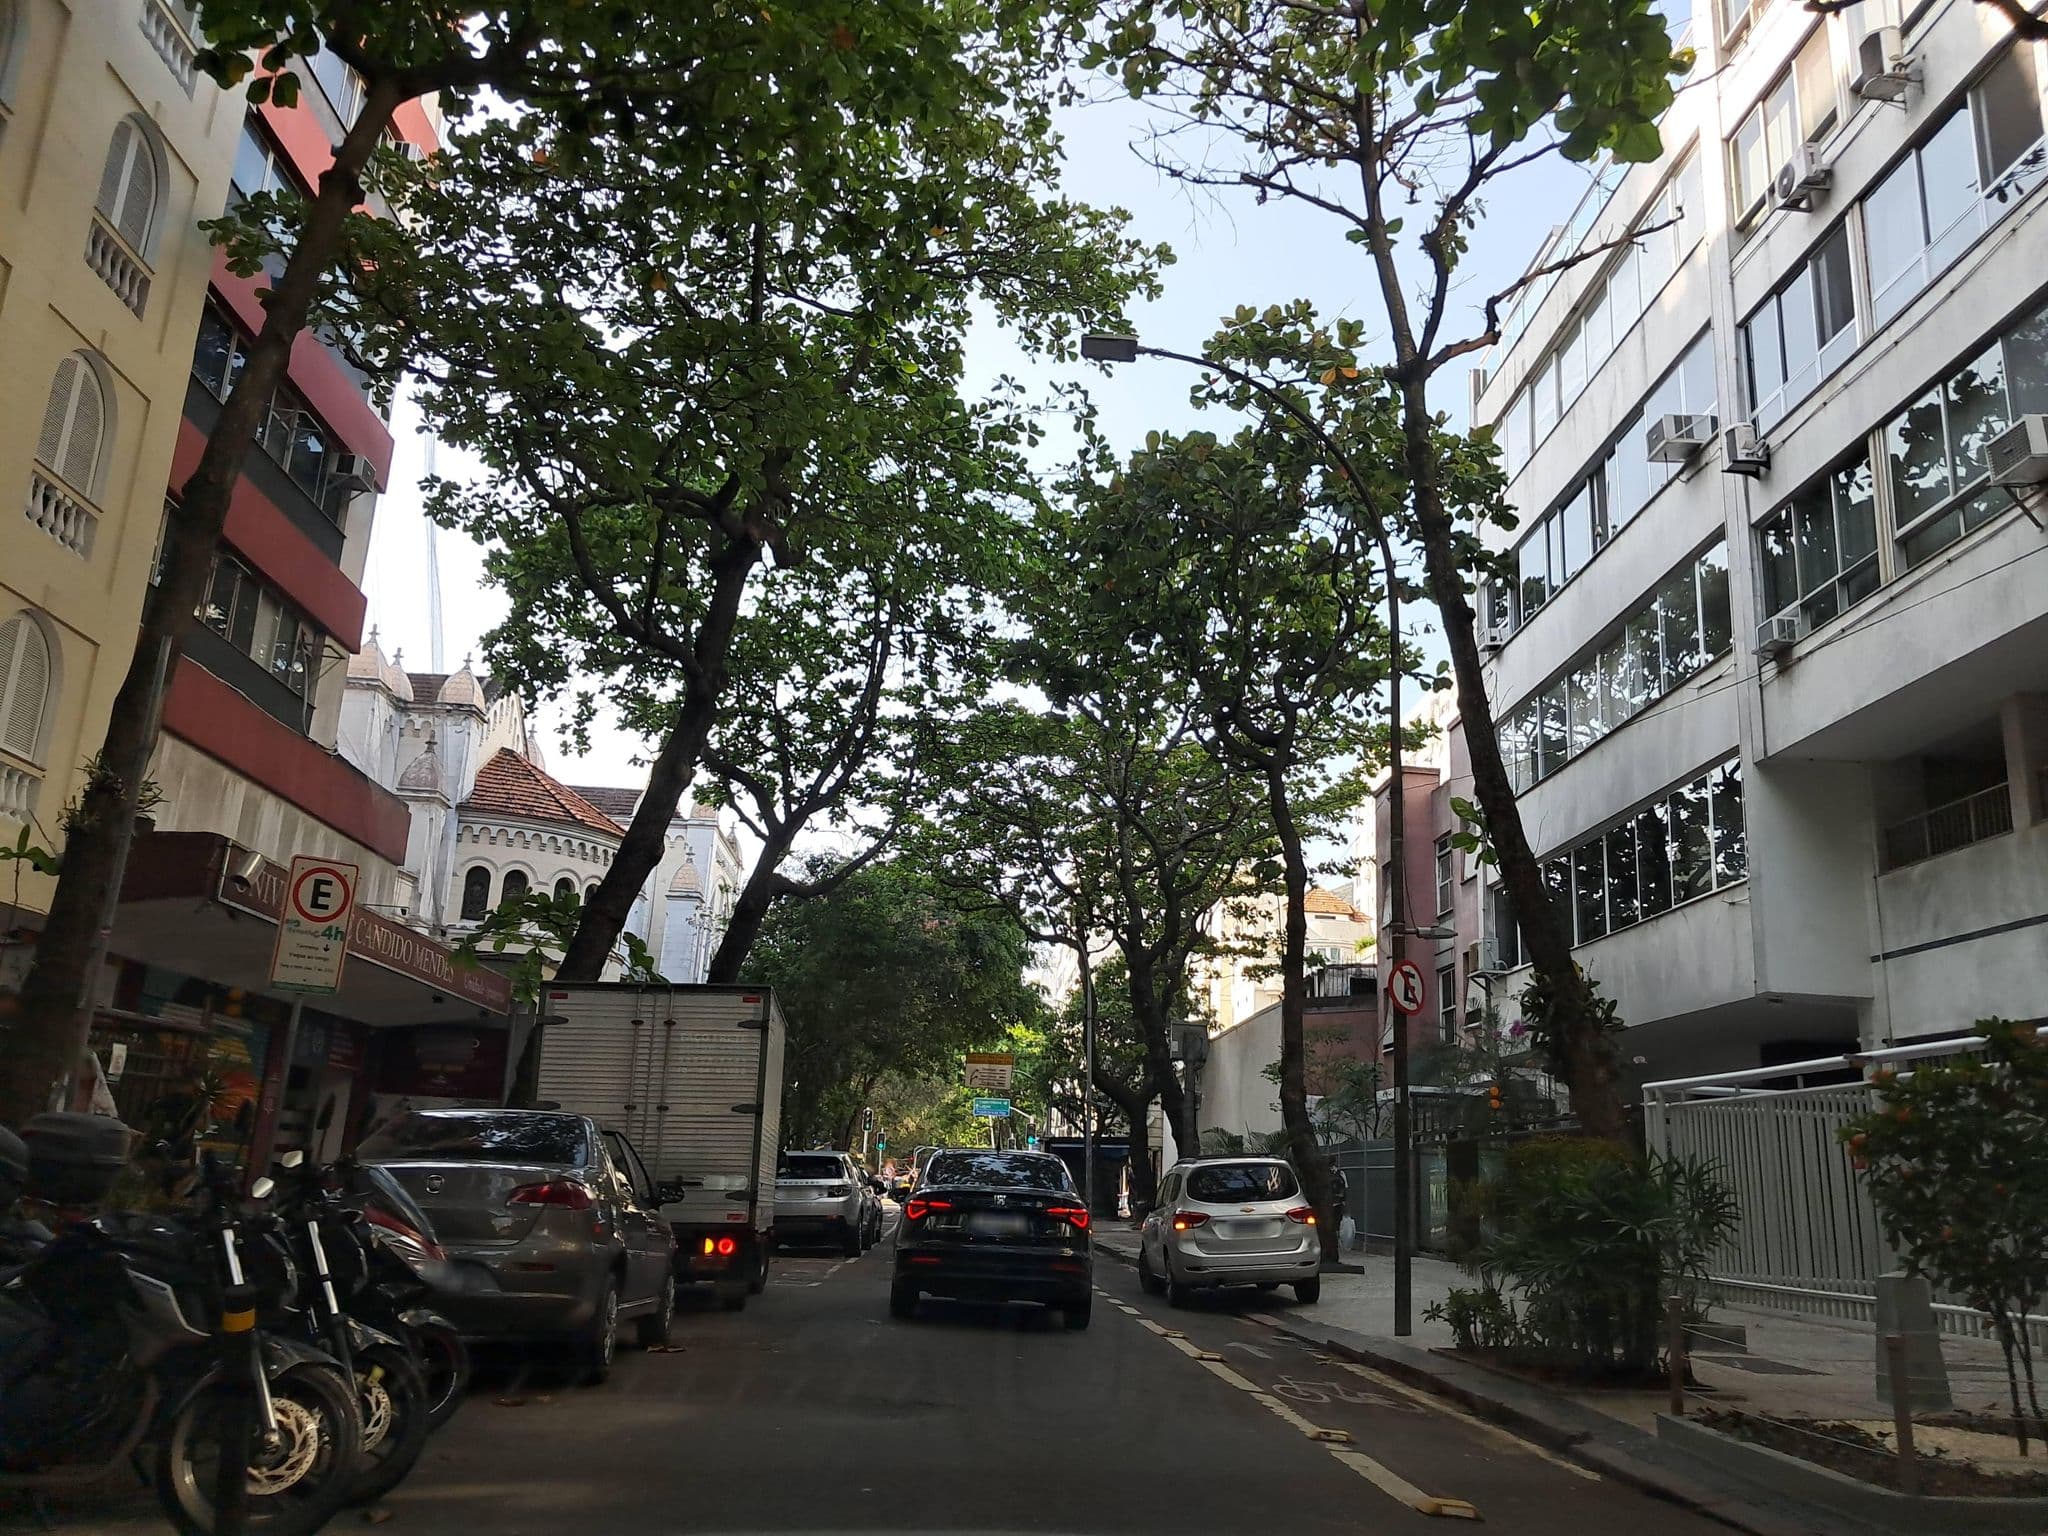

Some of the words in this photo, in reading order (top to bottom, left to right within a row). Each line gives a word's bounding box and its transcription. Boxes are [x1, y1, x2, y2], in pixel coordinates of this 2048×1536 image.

[310, 878, 333, 911] E
[320, 925, 345, 941] 4h
[355, 917, 412, 964] CANDIDO
